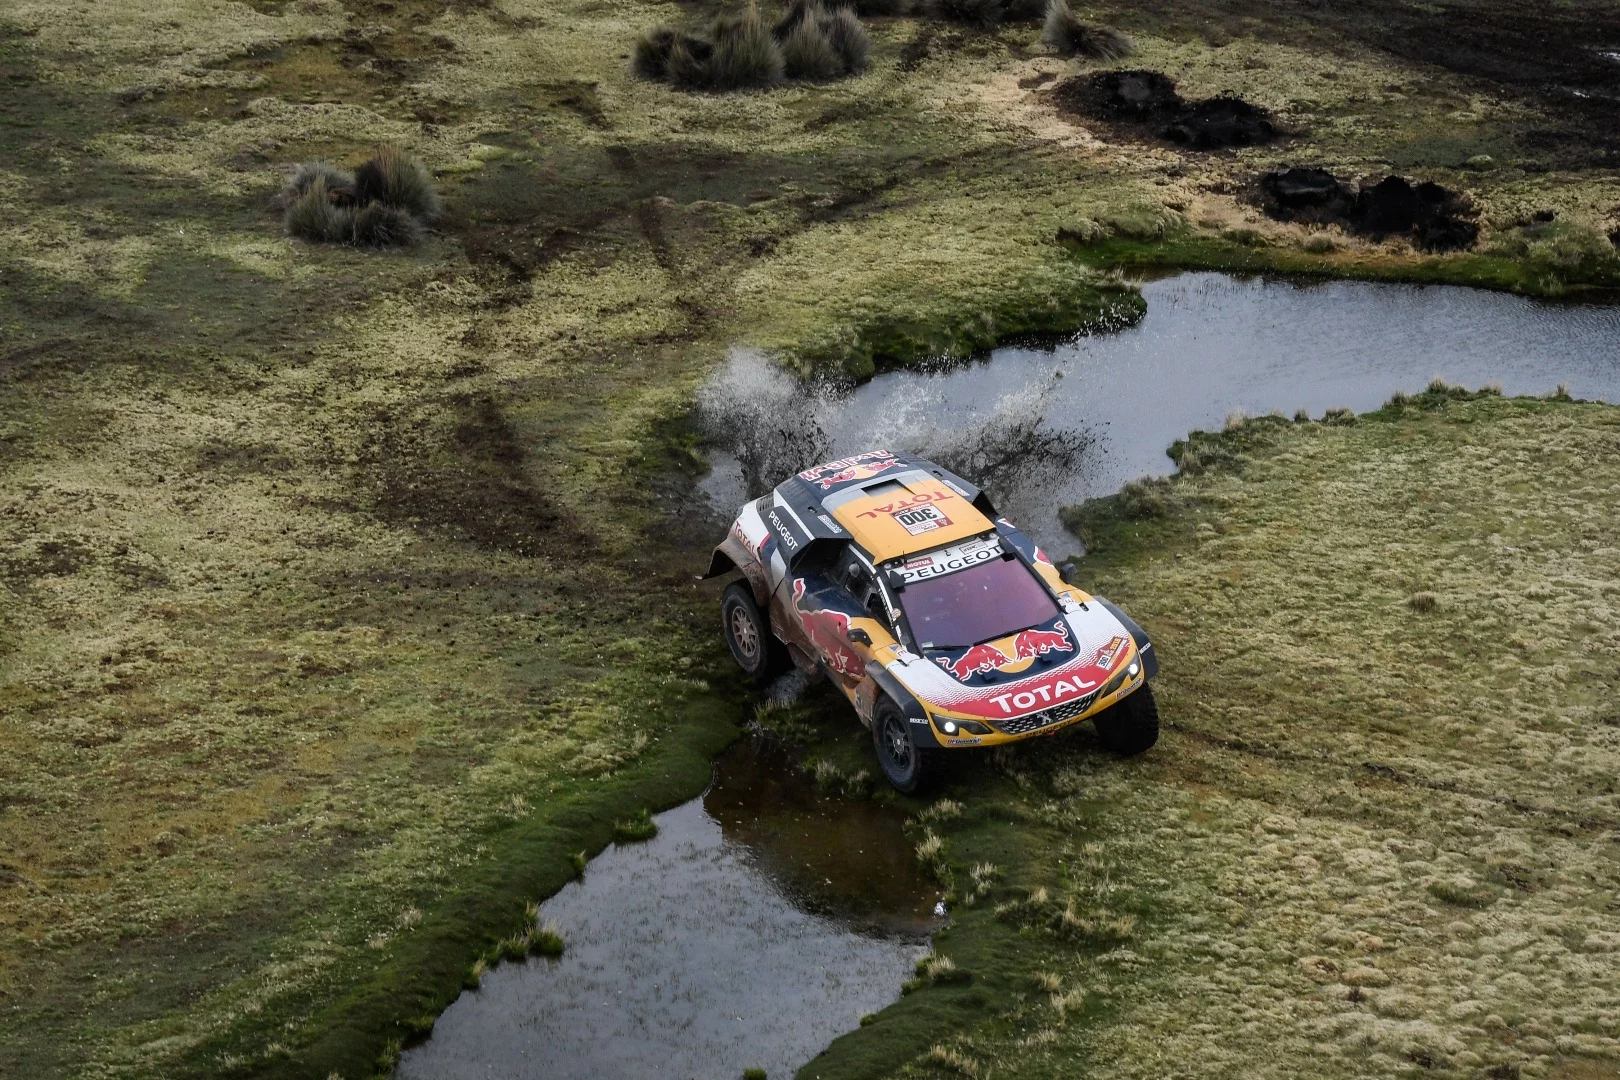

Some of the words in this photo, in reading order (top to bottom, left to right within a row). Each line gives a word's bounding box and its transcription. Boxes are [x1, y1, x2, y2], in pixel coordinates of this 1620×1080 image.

[856, 491, 954, 518] TOTAL
[899, 508, 938, 526] 300
[735, 521, 756, 554] TOTAL
[768, 510, 798, 551] PEUGEOT
[902, 545, 1001, 580] PEUGEOT
[907, 560, 931, 569] MOTUL
[989, 675, 1096, 713] TOTAL
[1025, 720, 1073, 738] PEUGEOT
